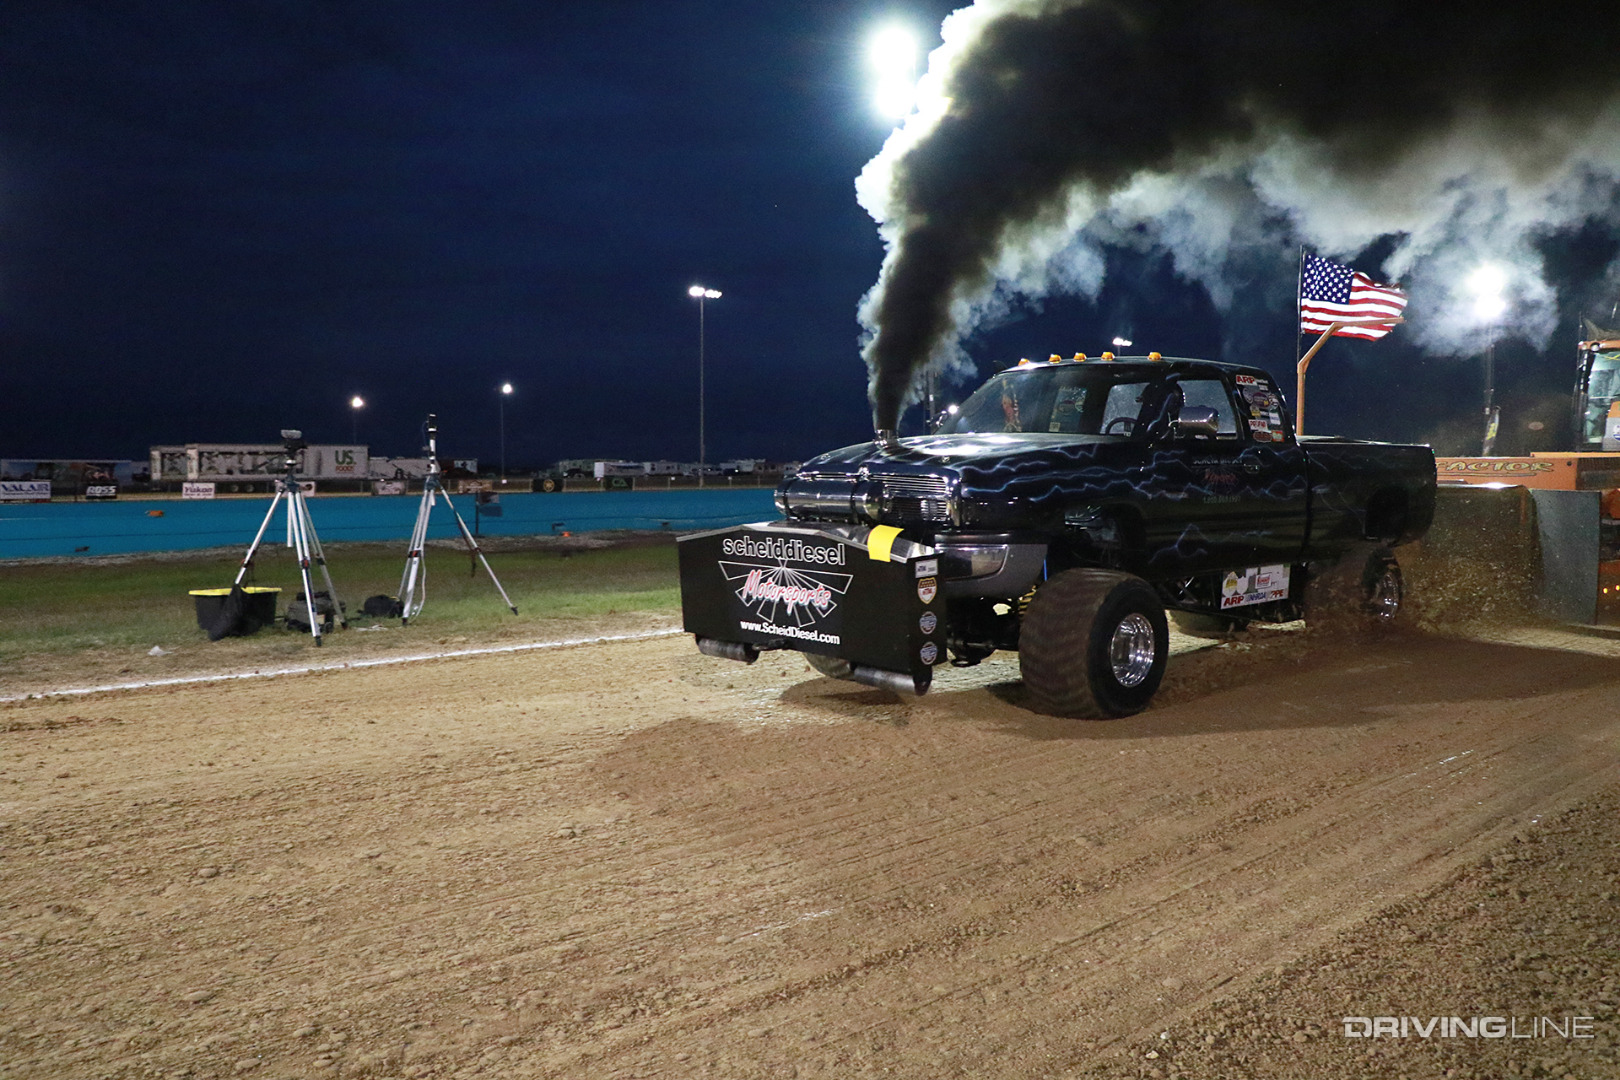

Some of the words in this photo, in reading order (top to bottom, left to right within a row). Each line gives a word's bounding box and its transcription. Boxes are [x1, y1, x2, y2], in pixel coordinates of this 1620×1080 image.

[86, 485, 117, 494] ROSS
[723, 536, 845, 565] scheiddiesel
[742, 569, 832, 614] Motorsports
[1223, 595, 1244, 606] ARP
[740, 620, 840, 645] www.ScheidDiesel.com
